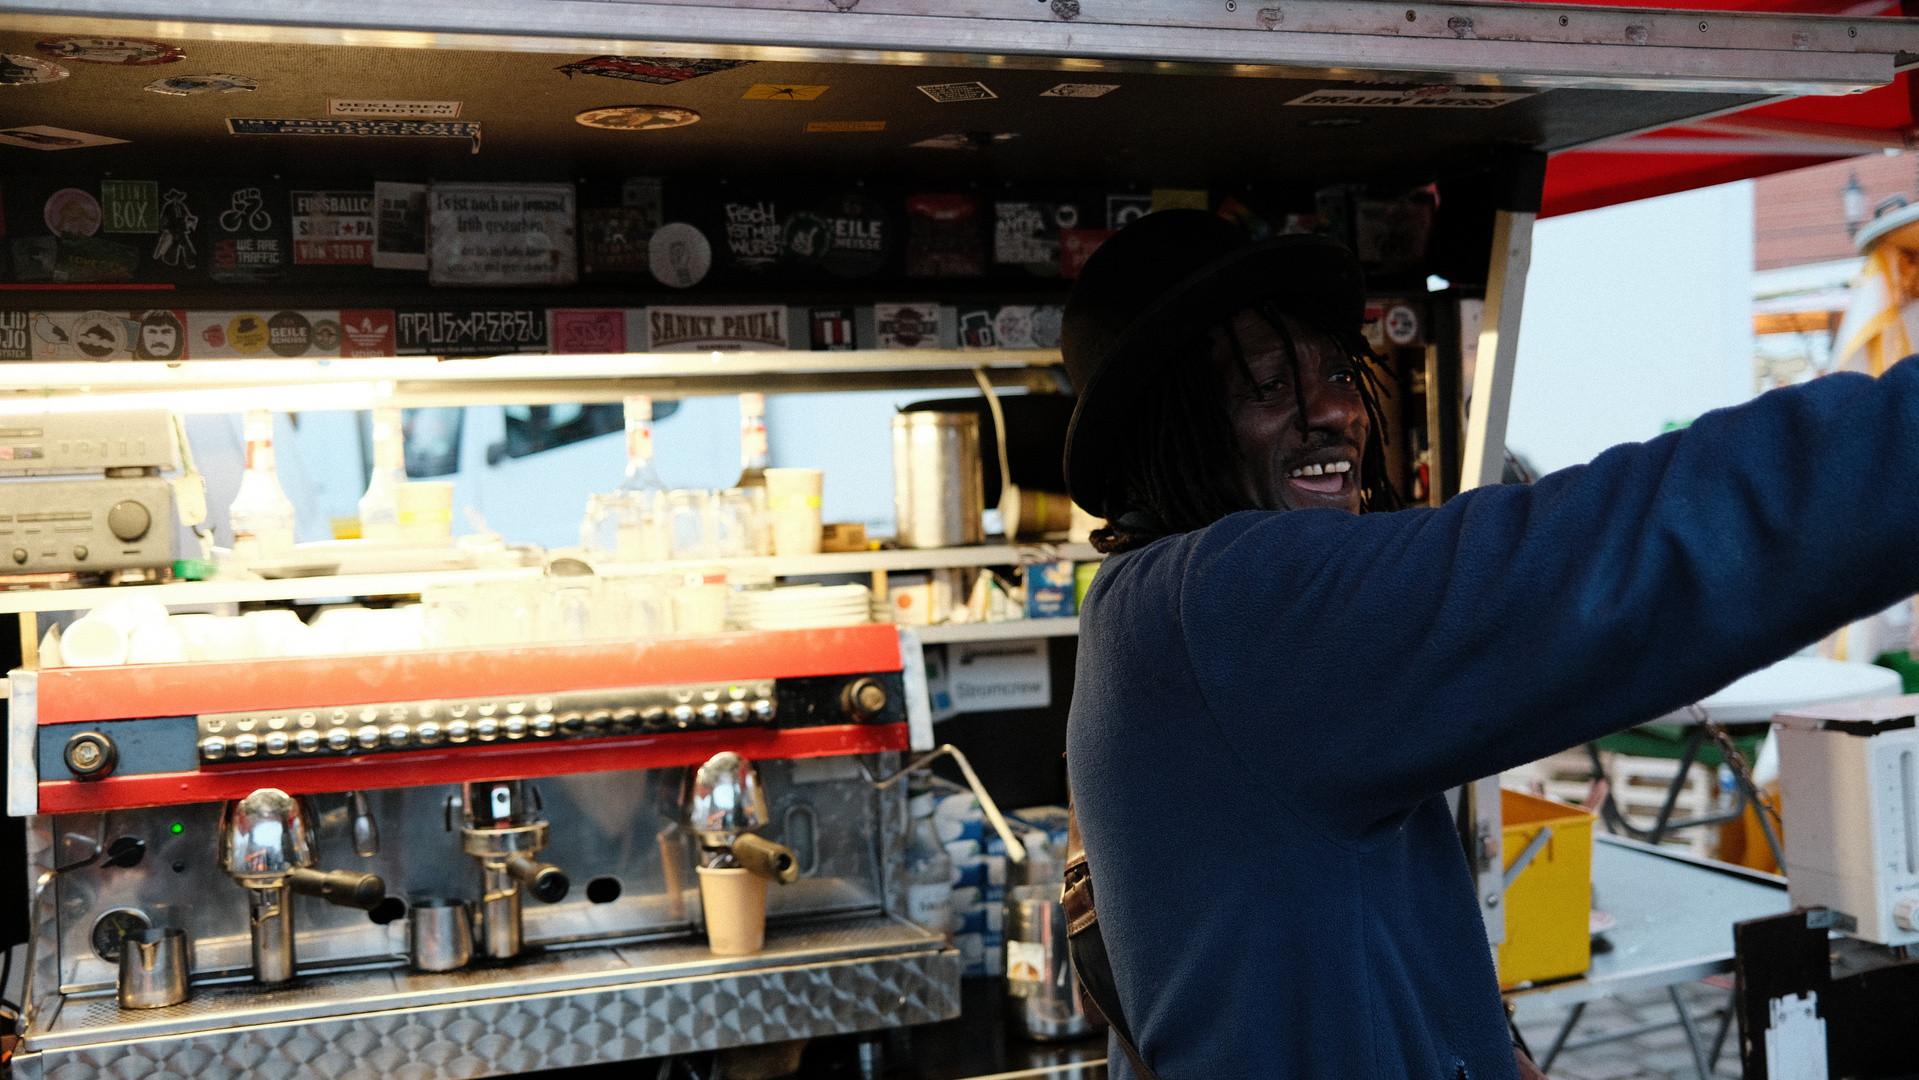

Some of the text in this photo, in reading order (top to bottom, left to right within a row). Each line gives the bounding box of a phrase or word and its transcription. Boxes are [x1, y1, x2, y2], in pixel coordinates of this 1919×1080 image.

[112, 201, 148, 229] BOX
[357, 221, 374, 236] PA
[236, 239, 279, 251] WE ARE
[236, 252, 280, 264] TRAFFIC
[0, 311, 27, 330] LID
[651, 310, 716, 342] SANKT
[722, 310, 781, 341] PAULI
[0, 330, 27, 349] JO
[270, 327, 307, 338] GEILE
